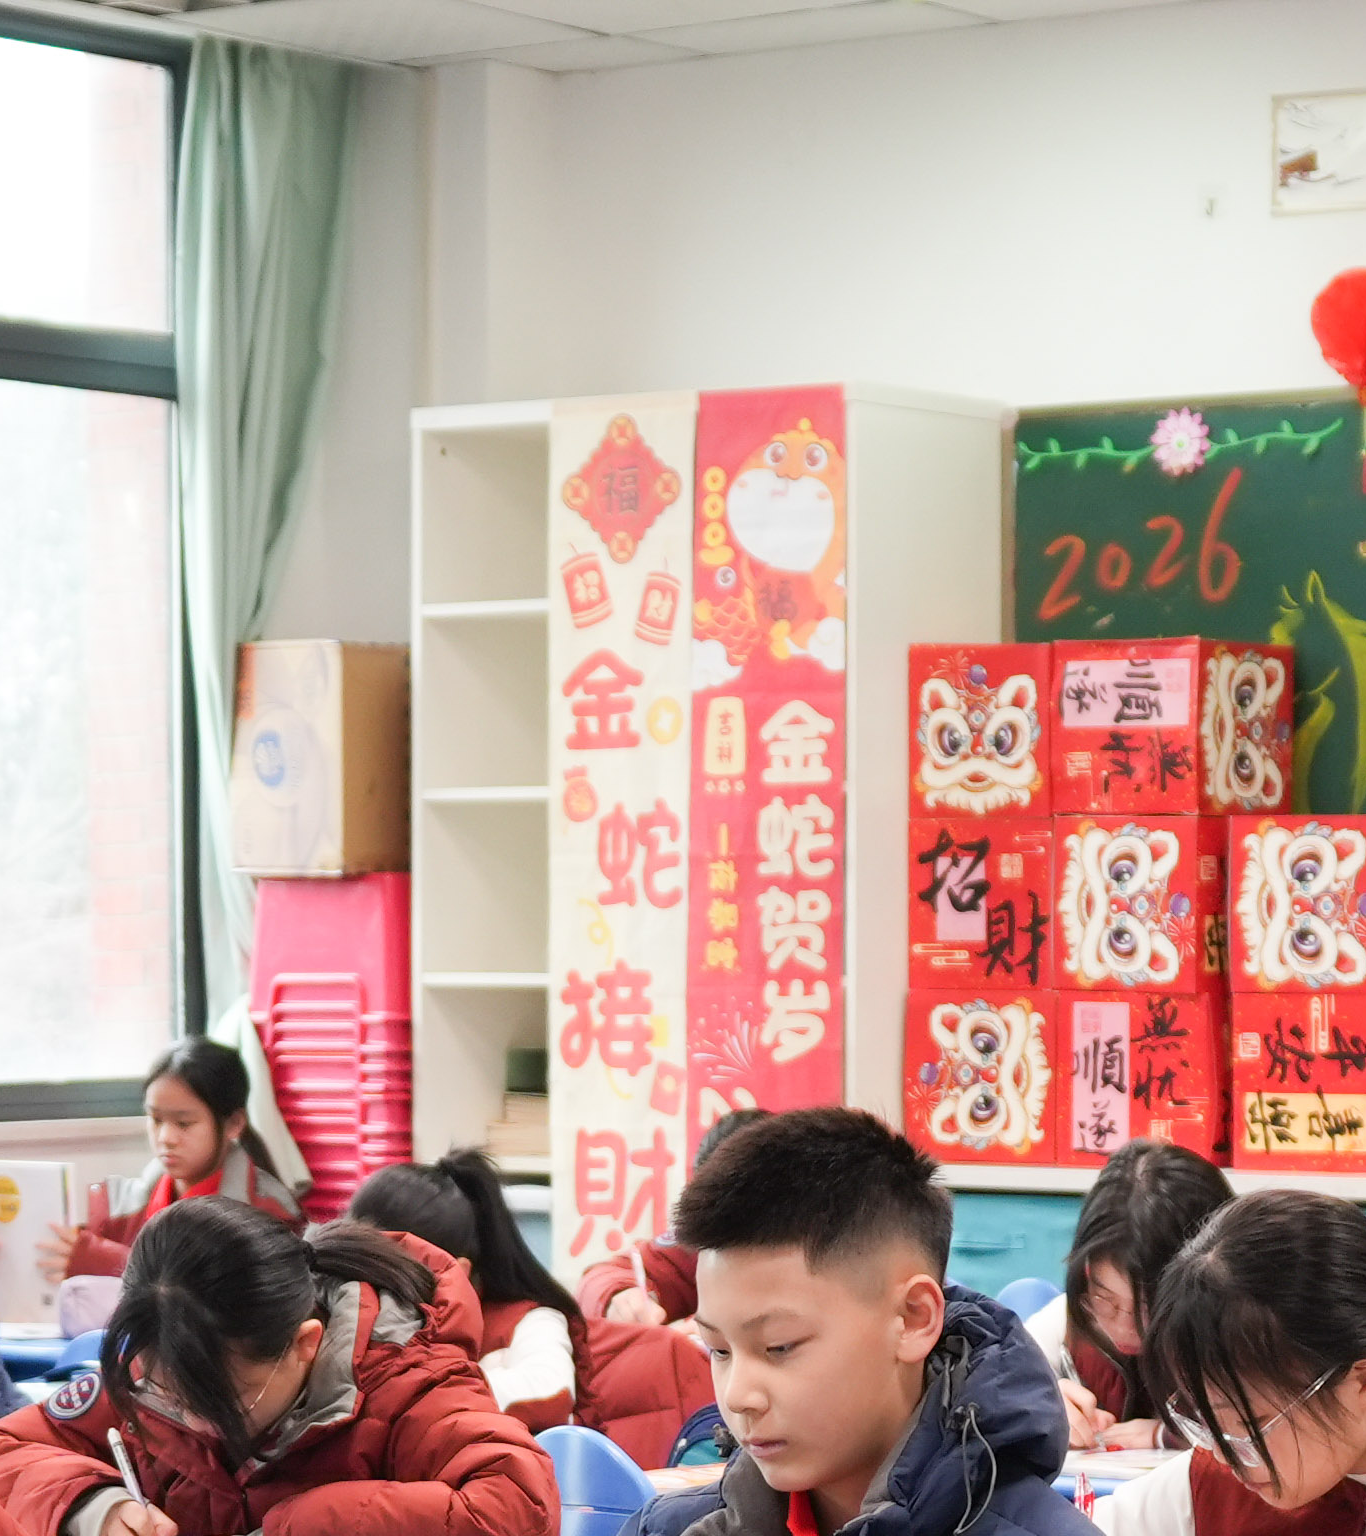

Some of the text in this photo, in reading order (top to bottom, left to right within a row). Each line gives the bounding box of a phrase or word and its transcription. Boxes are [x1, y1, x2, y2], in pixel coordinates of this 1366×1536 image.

[601, 466, 640, 515] 福
[1039, 468, 1242, 624] 2026
[756, 699, 835, 1063] 金蛇贺岁
